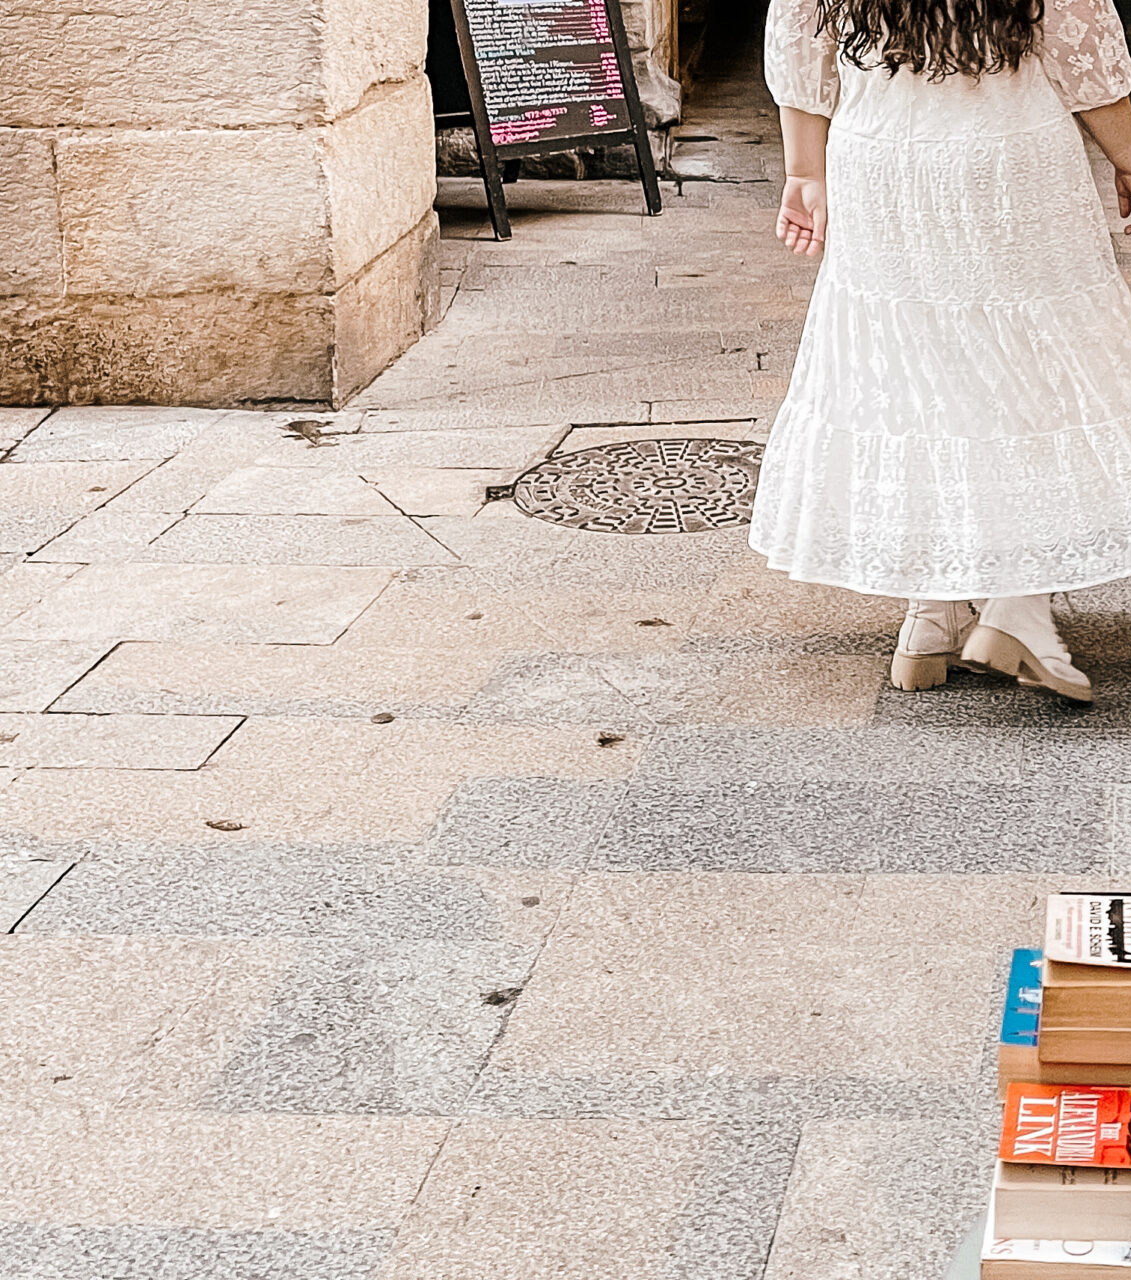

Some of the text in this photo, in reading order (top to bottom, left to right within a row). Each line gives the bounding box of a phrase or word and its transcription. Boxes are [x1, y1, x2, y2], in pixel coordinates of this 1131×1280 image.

[1089, 901, 1102, 925] DAVID
[1013, 1095, 1058, 1156] LINK
[1055, 1090, 1104, 1162] ALEXANDRIA
